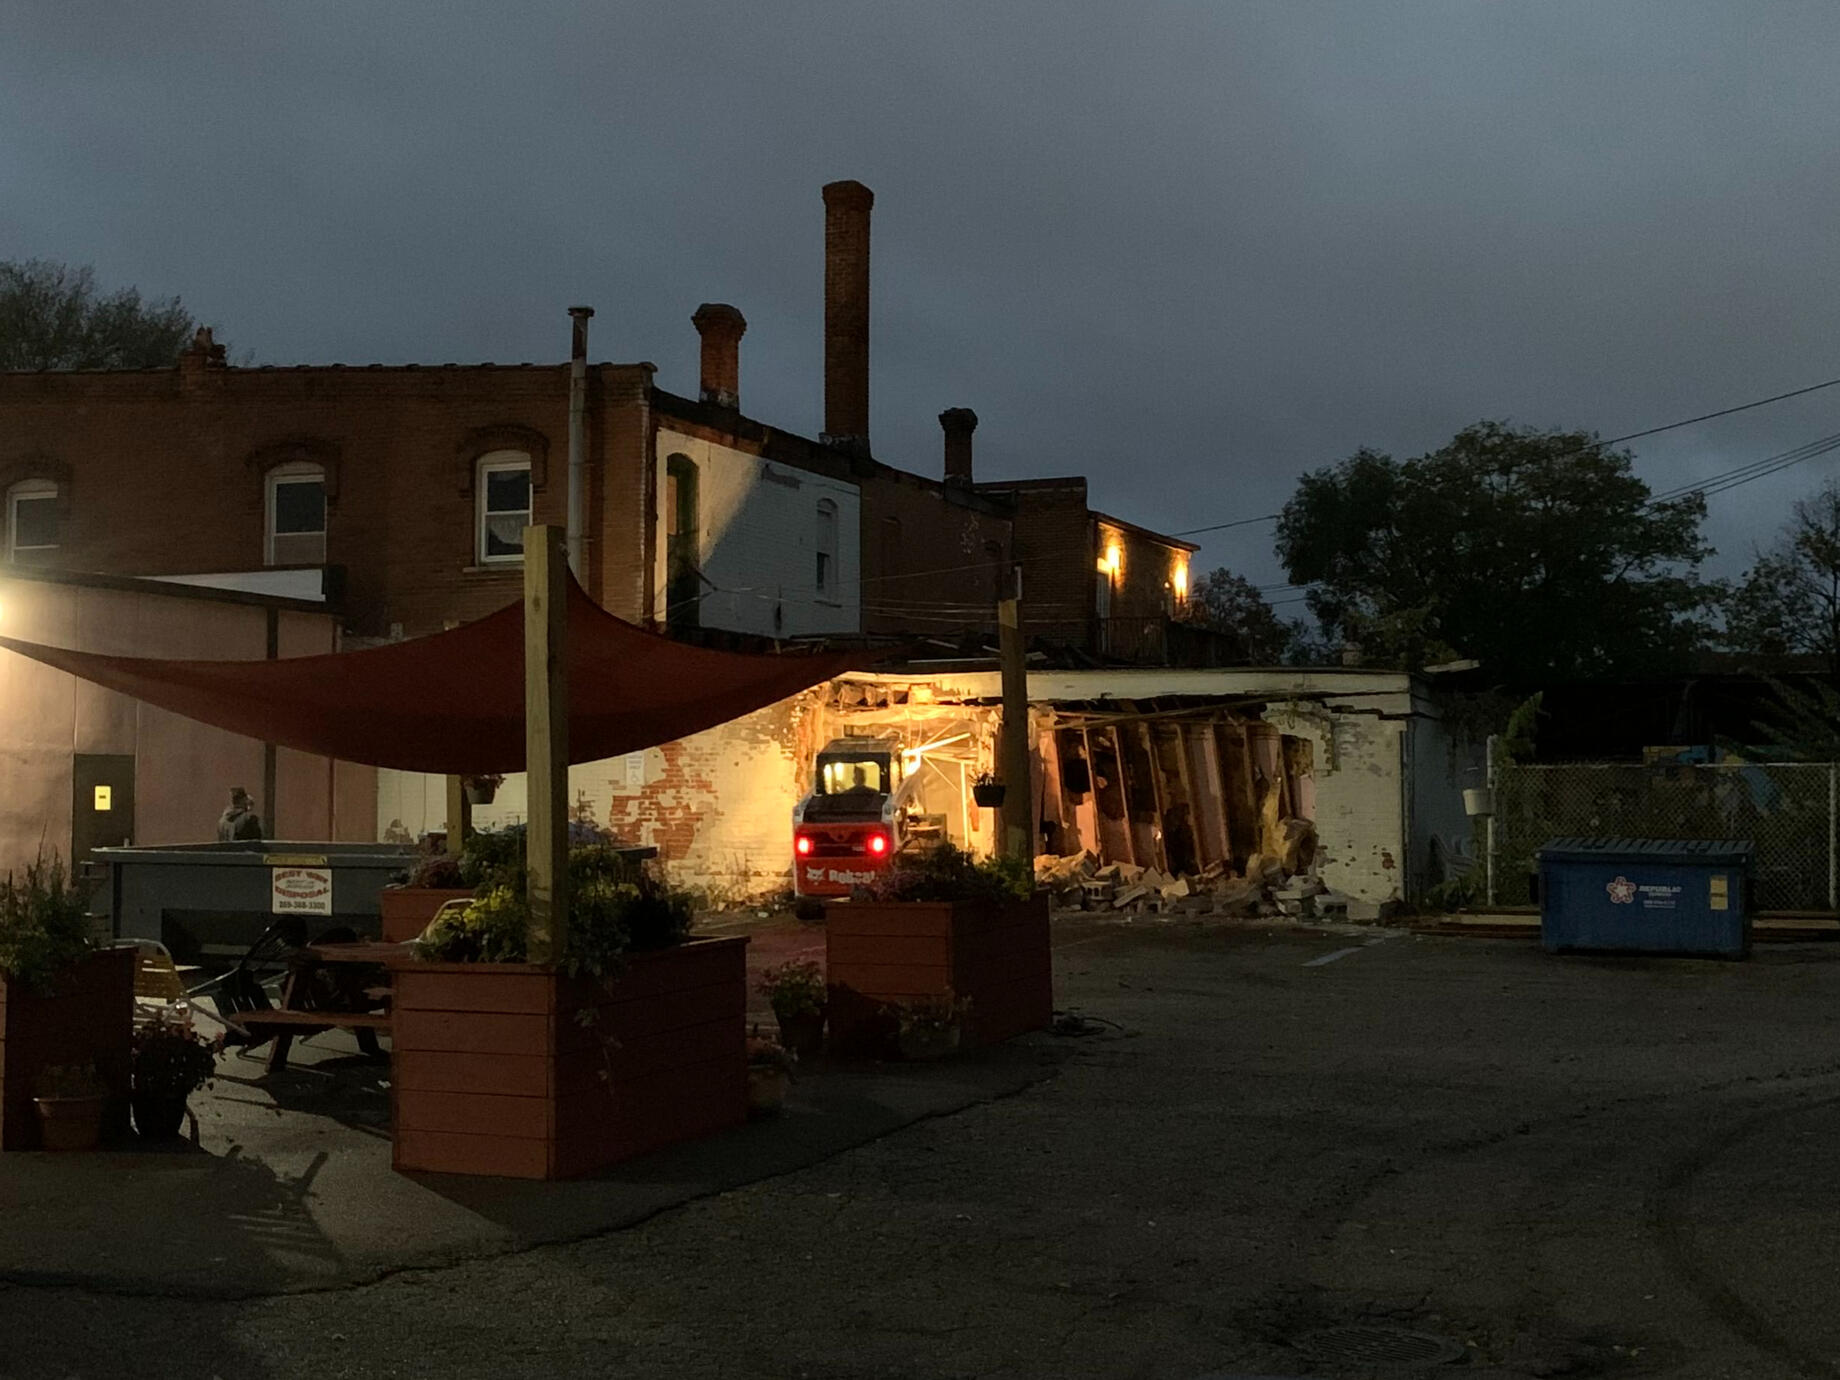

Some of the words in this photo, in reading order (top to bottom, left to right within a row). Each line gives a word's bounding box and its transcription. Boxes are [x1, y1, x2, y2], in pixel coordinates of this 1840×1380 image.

[275, 870, 302, 882] BEST
[829, 869, 875, 884] Bobcat
[275, 886, 329, 899] DISPOSAL
